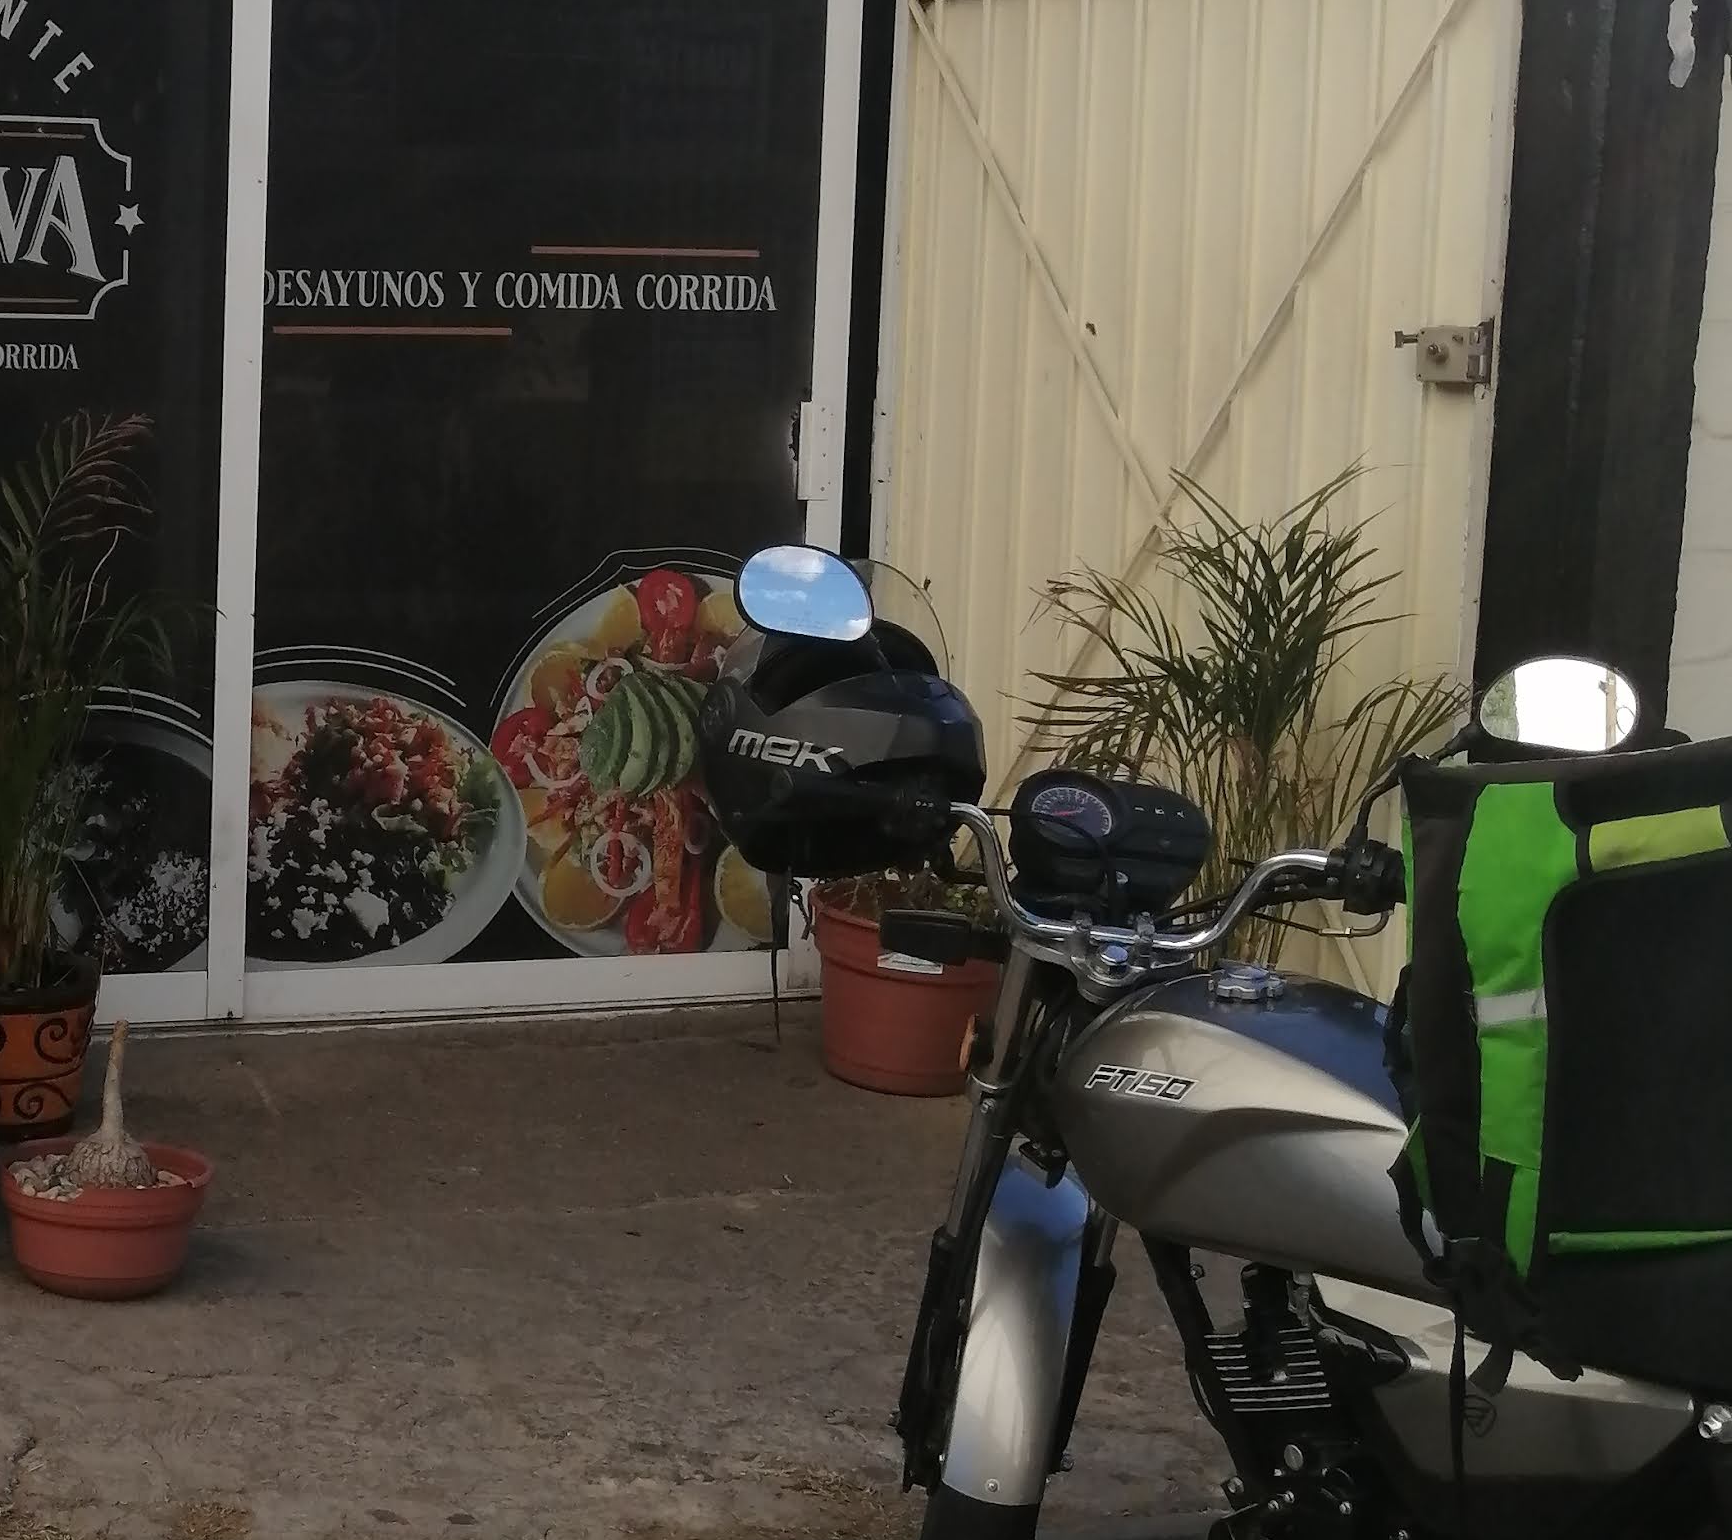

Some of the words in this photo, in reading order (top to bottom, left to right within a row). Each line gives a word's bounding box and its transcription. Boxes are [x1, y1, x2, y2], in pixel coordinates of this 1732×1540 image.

[460, 272, 482, 308] Y
[495, 272, 624, 310] COMIDA
[636, 274, 778, 311] CORRIDA
